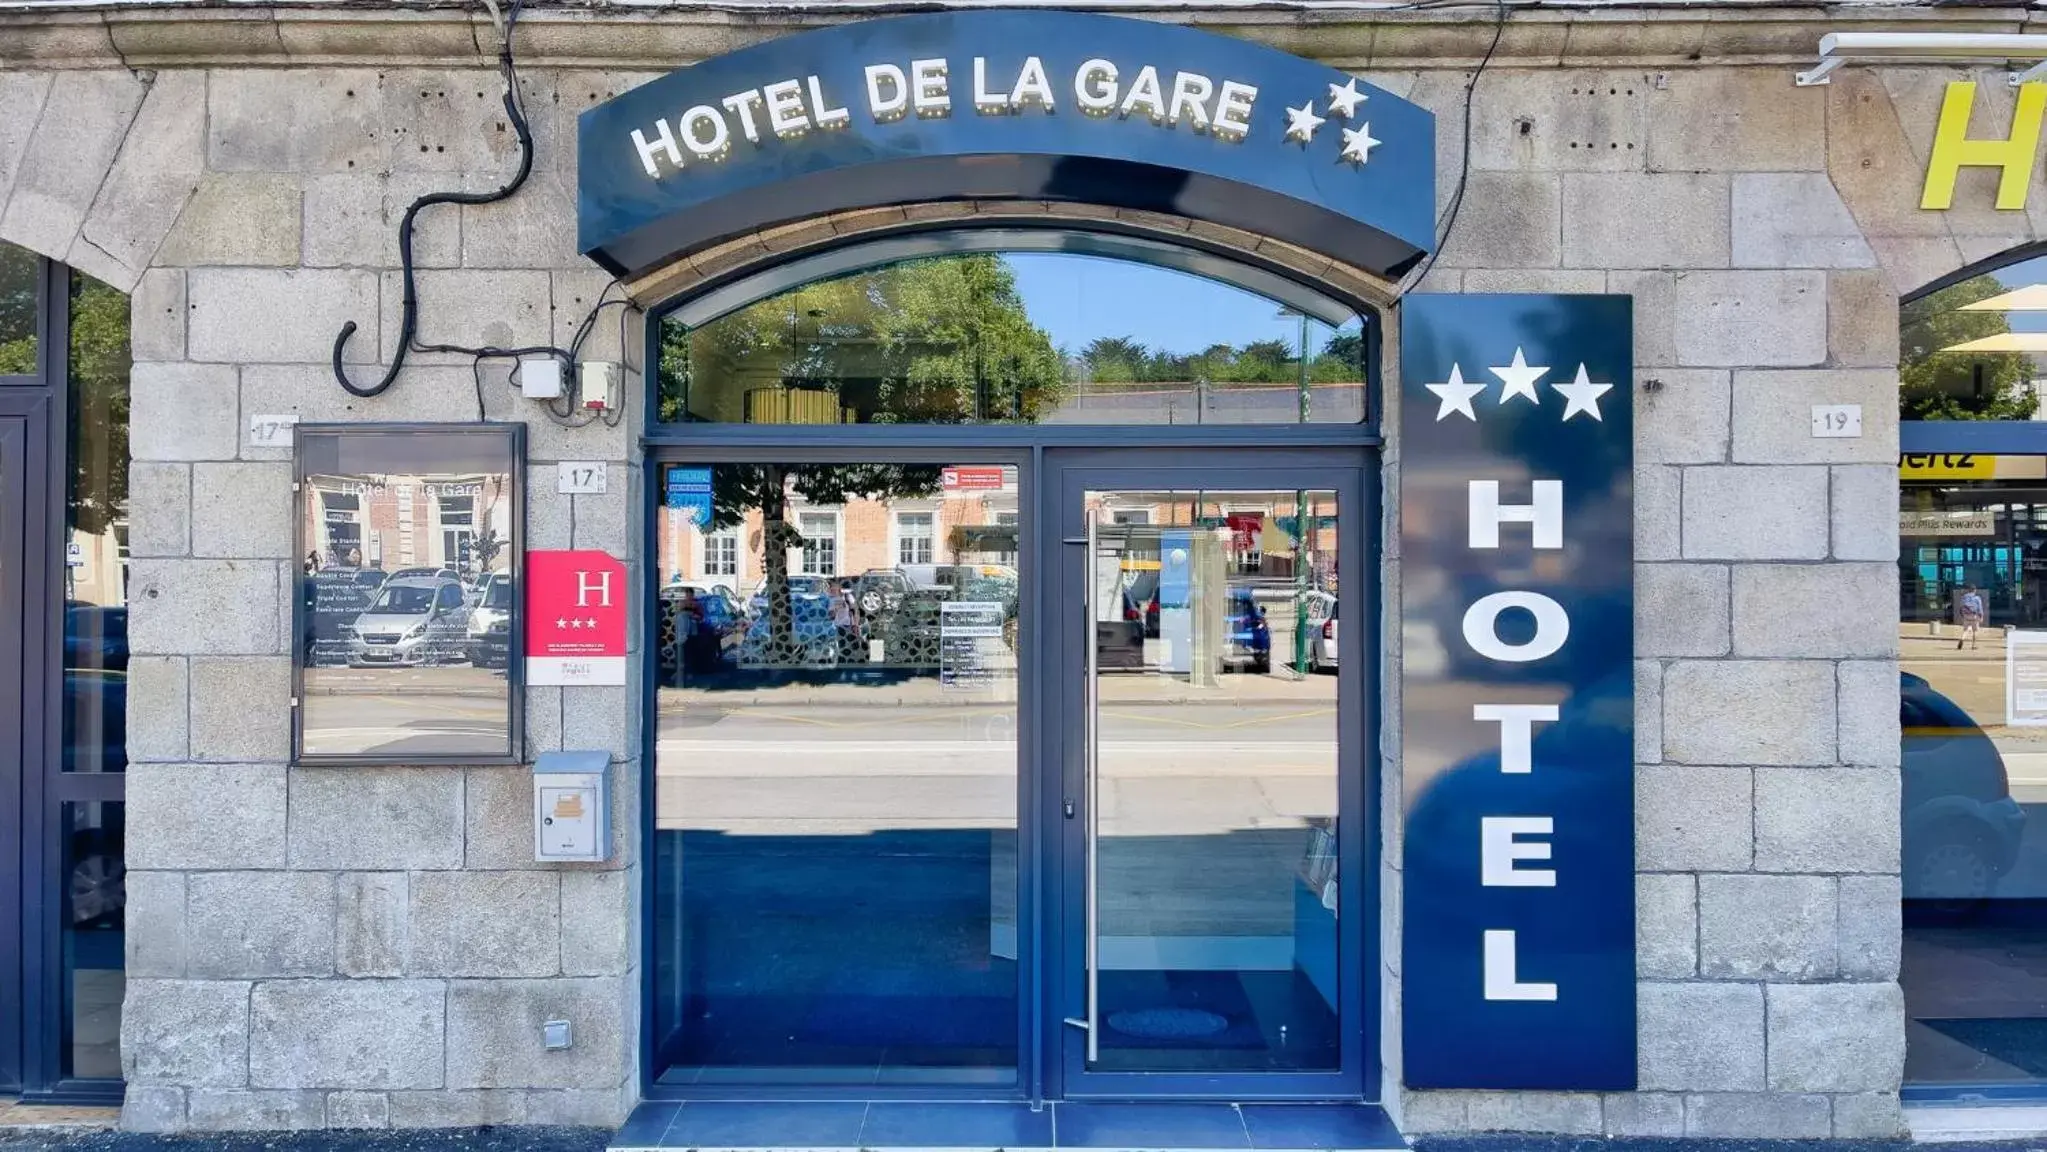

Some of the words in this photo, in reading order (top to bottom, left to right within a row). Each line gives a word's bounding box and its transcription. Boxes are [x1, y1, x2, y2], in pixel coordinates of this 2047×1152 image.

[631, 76, 850, 180] HOTEL
[865, 58, 951, 119] DE
[973, 56, 1056, 110] LA
[1074, 58, 1259, 138] GARE
[1920, 81, 2047, 210] H
[1825, 411, 1848, 431] 19
[1898, 453, 1976, 469] ertz
[571, 469, 594, 487] 17
[1942, 519, 1988, 530] Rewards
[574, 571, 614, 607] H
[1462, 479, 1570, 1001] HOTEL
